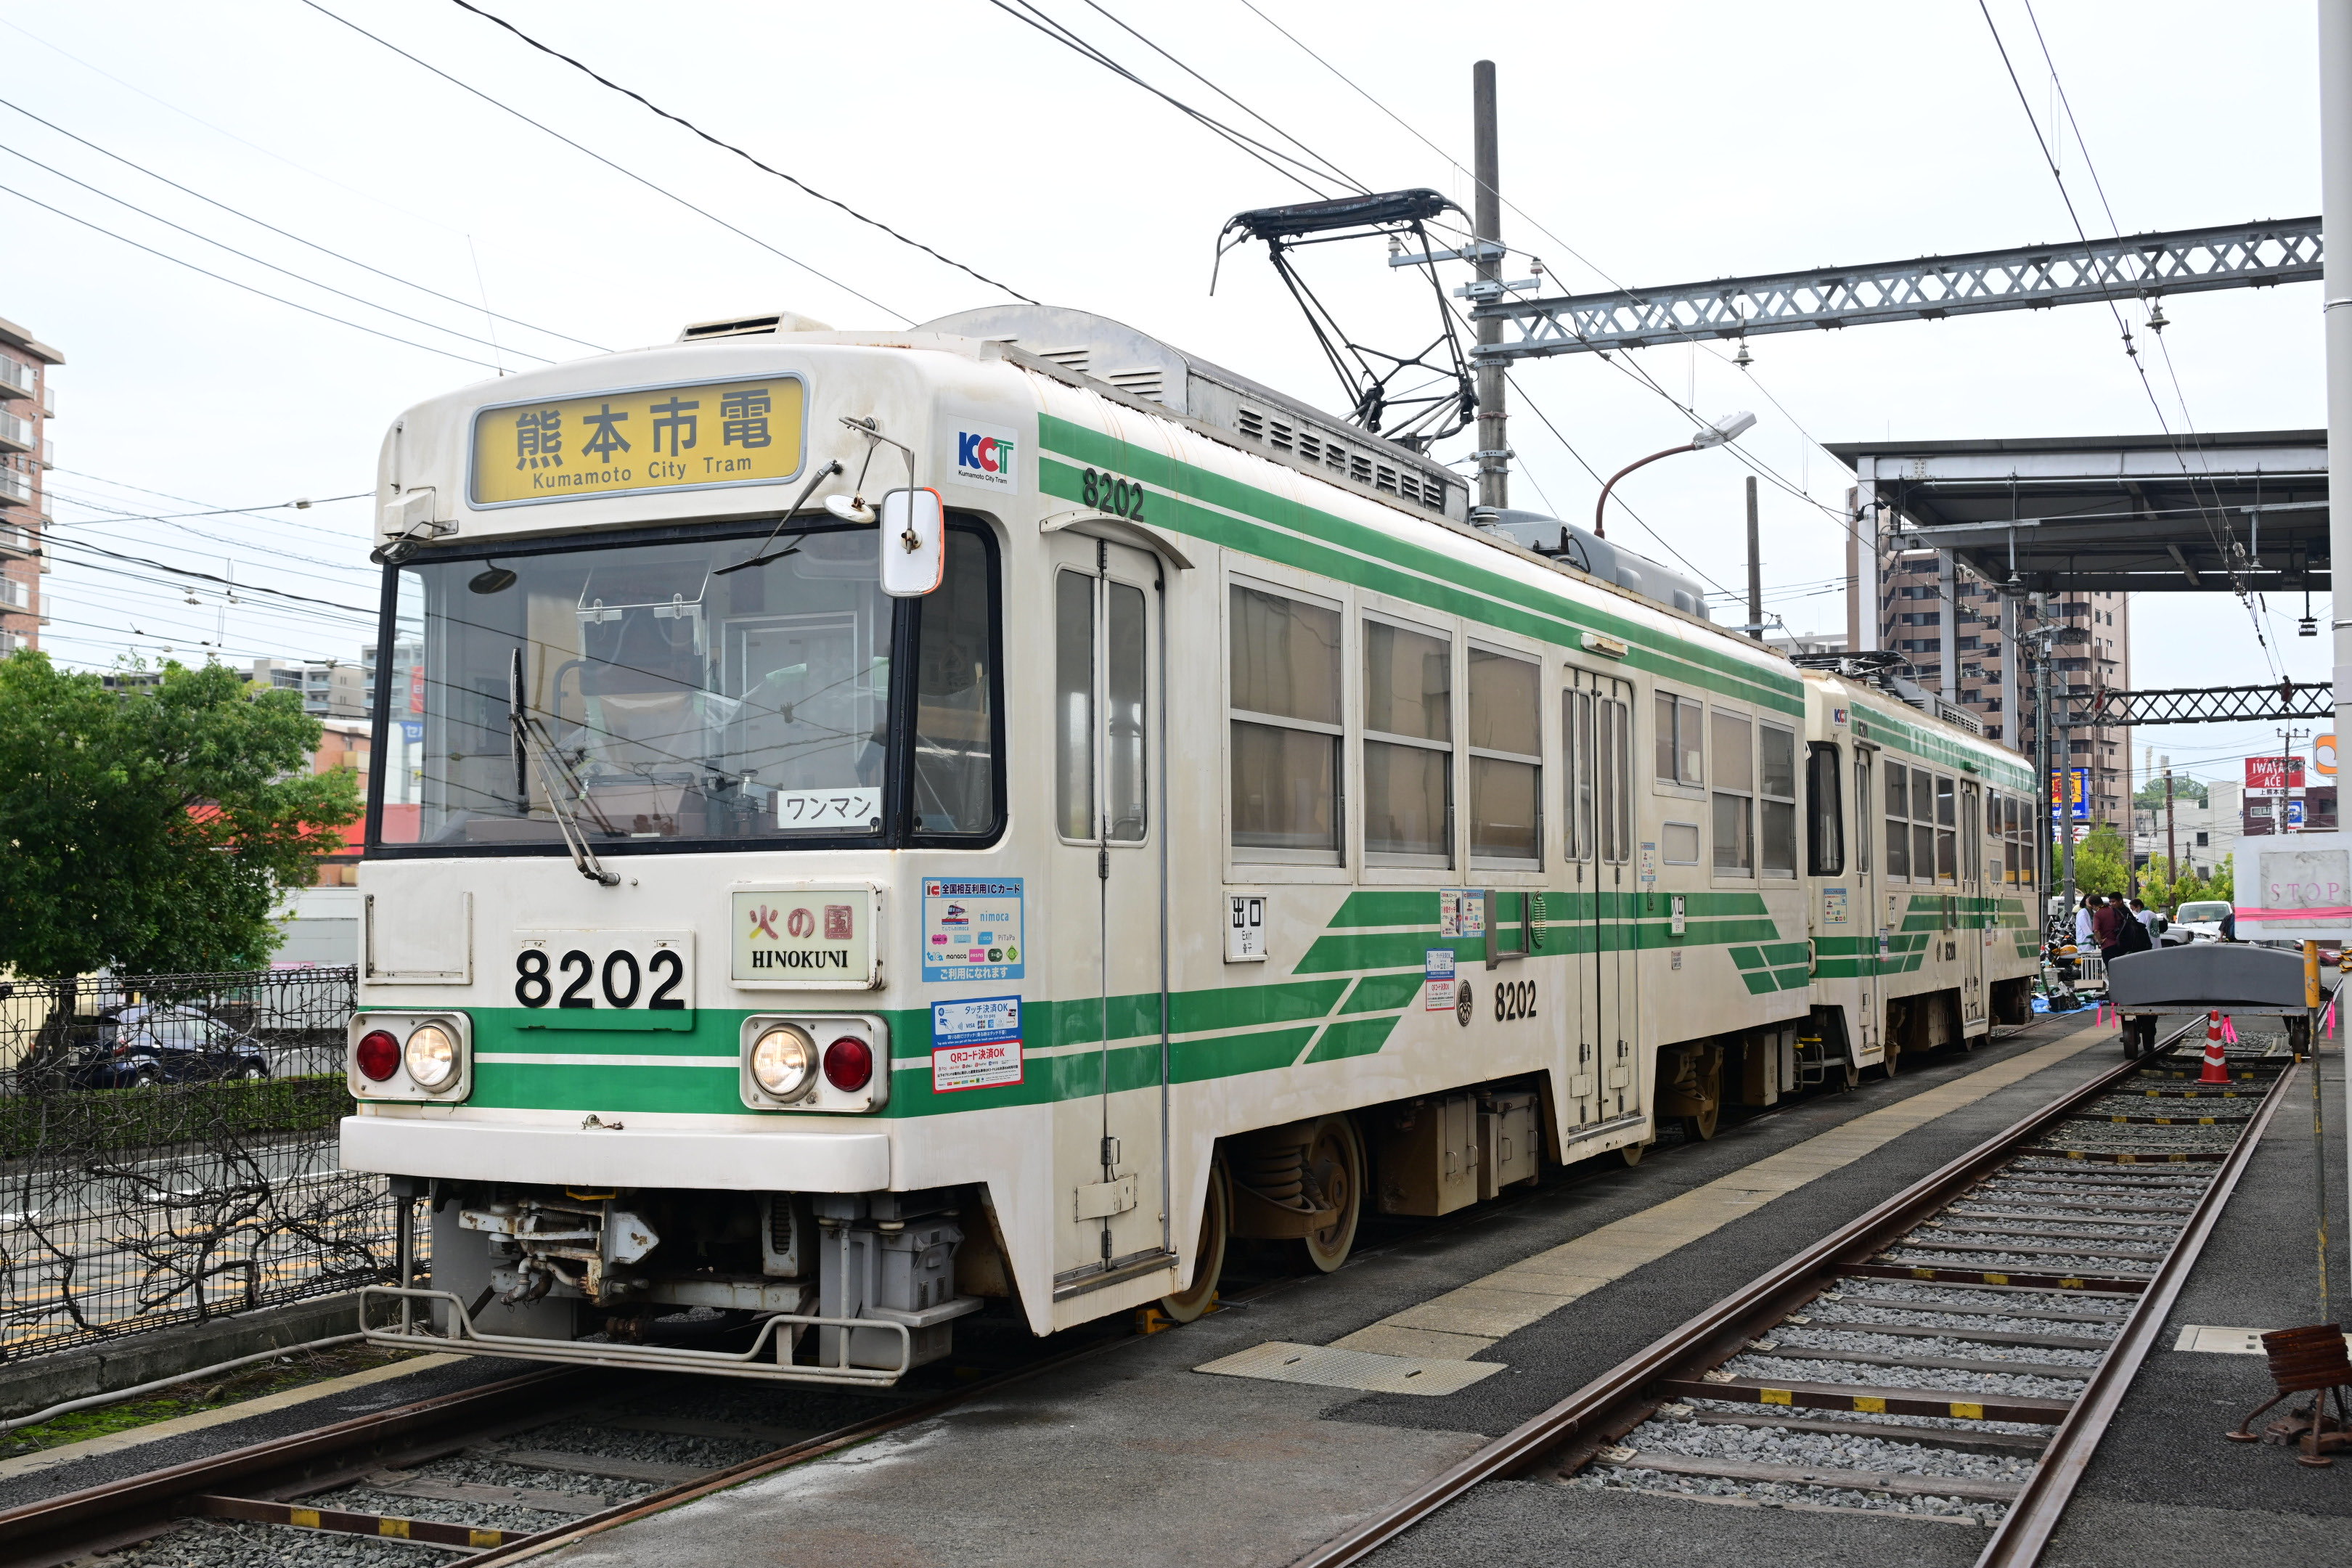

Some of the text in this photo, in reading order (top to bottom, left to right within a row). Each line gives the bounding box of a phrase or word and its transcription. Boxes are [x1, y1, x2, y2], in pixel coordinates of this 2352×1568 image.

[516, 389, 772, 471] 熊本市電
[959, 431, 1014, 474] KCT
[534, 457, 752, 489] Kumamoto City Tram
[958, 470, 984, 480] Kumamoto
[1084, 467, 1144, 523] 8202
[2253, 759, 2295, 777] IWASA
[2264, 776, 2281, 787] ACE
[787, 796, 871, 820] ワンマン
[942, 883, 1020, 894] 全国相互利用ICカード
[2271, 882, 2340, 902] STOP
[980, 910, 1009, 921] nimoca
[1233, 897, 1261, 928] 出口
[1672, 897, 1683, 915] 入口
[749, 905, 853, 940] 火の国
[1241, 930, 1252, 941] Exit
[751, 950, 849, 968] HINOKUNI
[1945, 941, 1956, 961] 8201
[515, 950, 687, 1010] 8202
[940, 966, 1008, 980] ご利用になれます
[965, 1003, 1008, 1014] タッチ決済OK
[1495, 979, 1537, 1021] 8202
[950, 1048, 1005, 1063] QRコード決済OK
